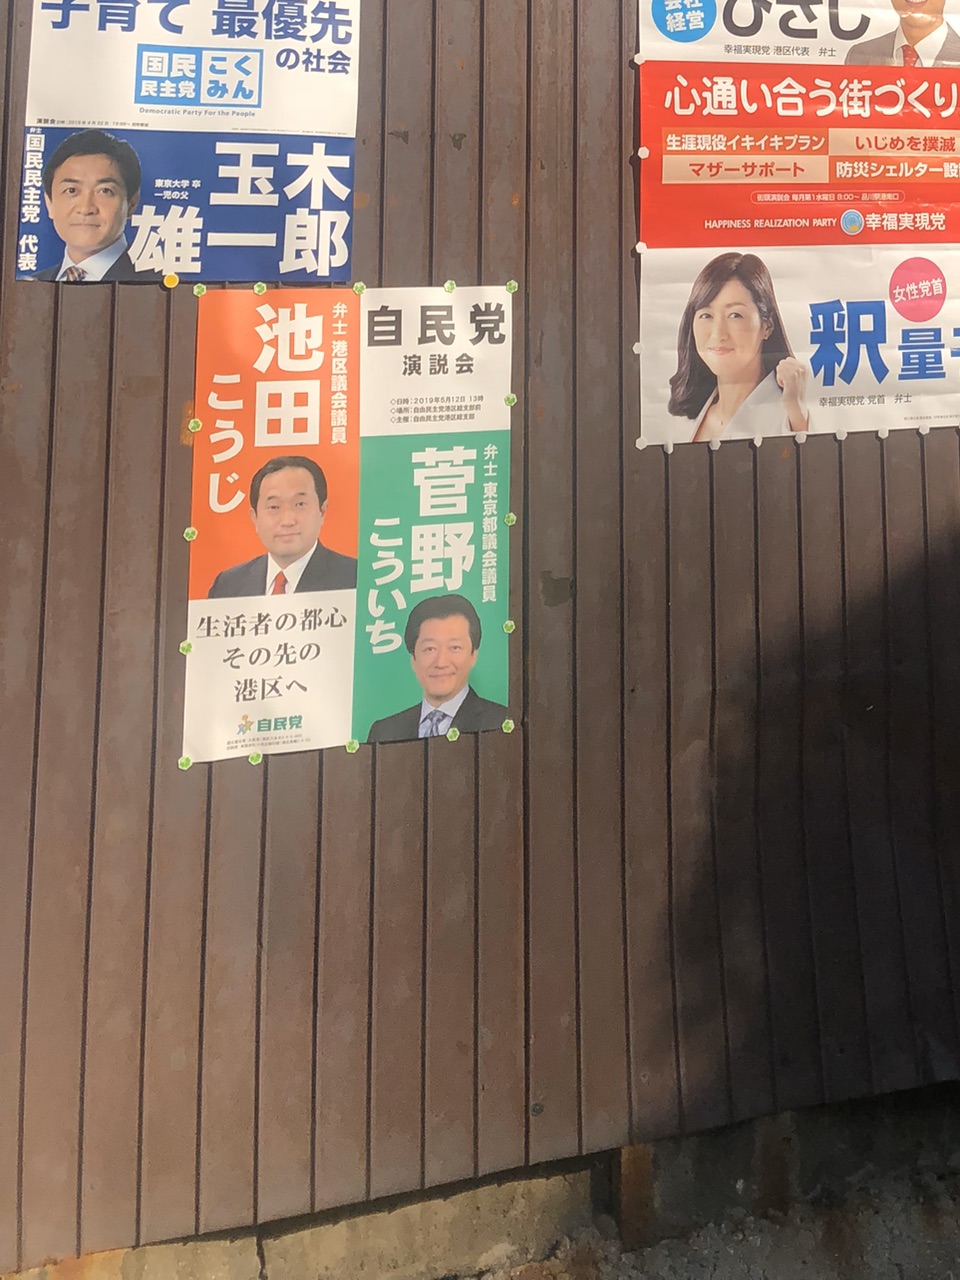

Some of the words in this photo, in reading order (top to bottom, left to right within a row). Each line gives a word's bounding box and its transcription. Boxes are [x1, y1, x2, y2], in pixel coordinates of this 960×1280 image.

[666, 11, 705, 32] 経営
[142, 51, 197, 78] 国民
[275, 47, 351, 75] の社会
[723, 44, 771, 57] 幸福実現党
[773, 45, 810, 57] 港区代表
[818, 47, 837, 58] 弁士
[208, 55, 252, 76] こく
[140, 81, 196, 99] 民主党
[206, 80, 254, 100] みん
[139, 107, 180, 116] Democratic
[182, 108, 203, 118] Party
[203, 109, 216, 117] For
[231, 110, 256, 119] People
[666, 134, 826, 152] 生涯現役イキイキプラン
[855, 136, 956, 152] いじめを撲滅
[21, 134, 45, 224] 国民民主党
[209, 141, 352, 210] 玉木
[688, 162, 806, 178] マザーサポート
[154, 179, 190, 189] 東京大学
[154, 190, 189, 200] 一児の父
[704, 219, 751, 230] HAPPINESS
[753, 218, 810, 230] REALIZATION
[812, 217, 837, 228] PARTY
[865, 212, 946, 231] 幸福実現党
[17, 234, 39, 271] 代表
[127, 205, 352, 277] 雄一郎
[892, 278, 944, 304] 女性党首
[332, 302, 348, 335] 弁士
[367, 302, 506, 347] 自民党
[253, 302, 325, 448] 池田
[402, 353, 474, 376] 演説会
[331, 340, 348, 444] 港区議会議員
[818, 395, 865, 408] 幸福実現党
[867, 394, 886, 405] 党首
[894, 393, 913, 404] 弁士
[207, 373, 245, 514] こうじ
[483, 444, 498, 477] 弁士
[410, 445, 477, 593] 菅野
[481, 482, 498, 602] 東京都議会議員
[365, 517, 407, 654] こういち
[196, 606, 348, 640] 生活者の都心
[222, 641, 321, 669] その先の
[234, 675, 308, 703] 港区へ
[256, 714, 303, 733] 自民党
